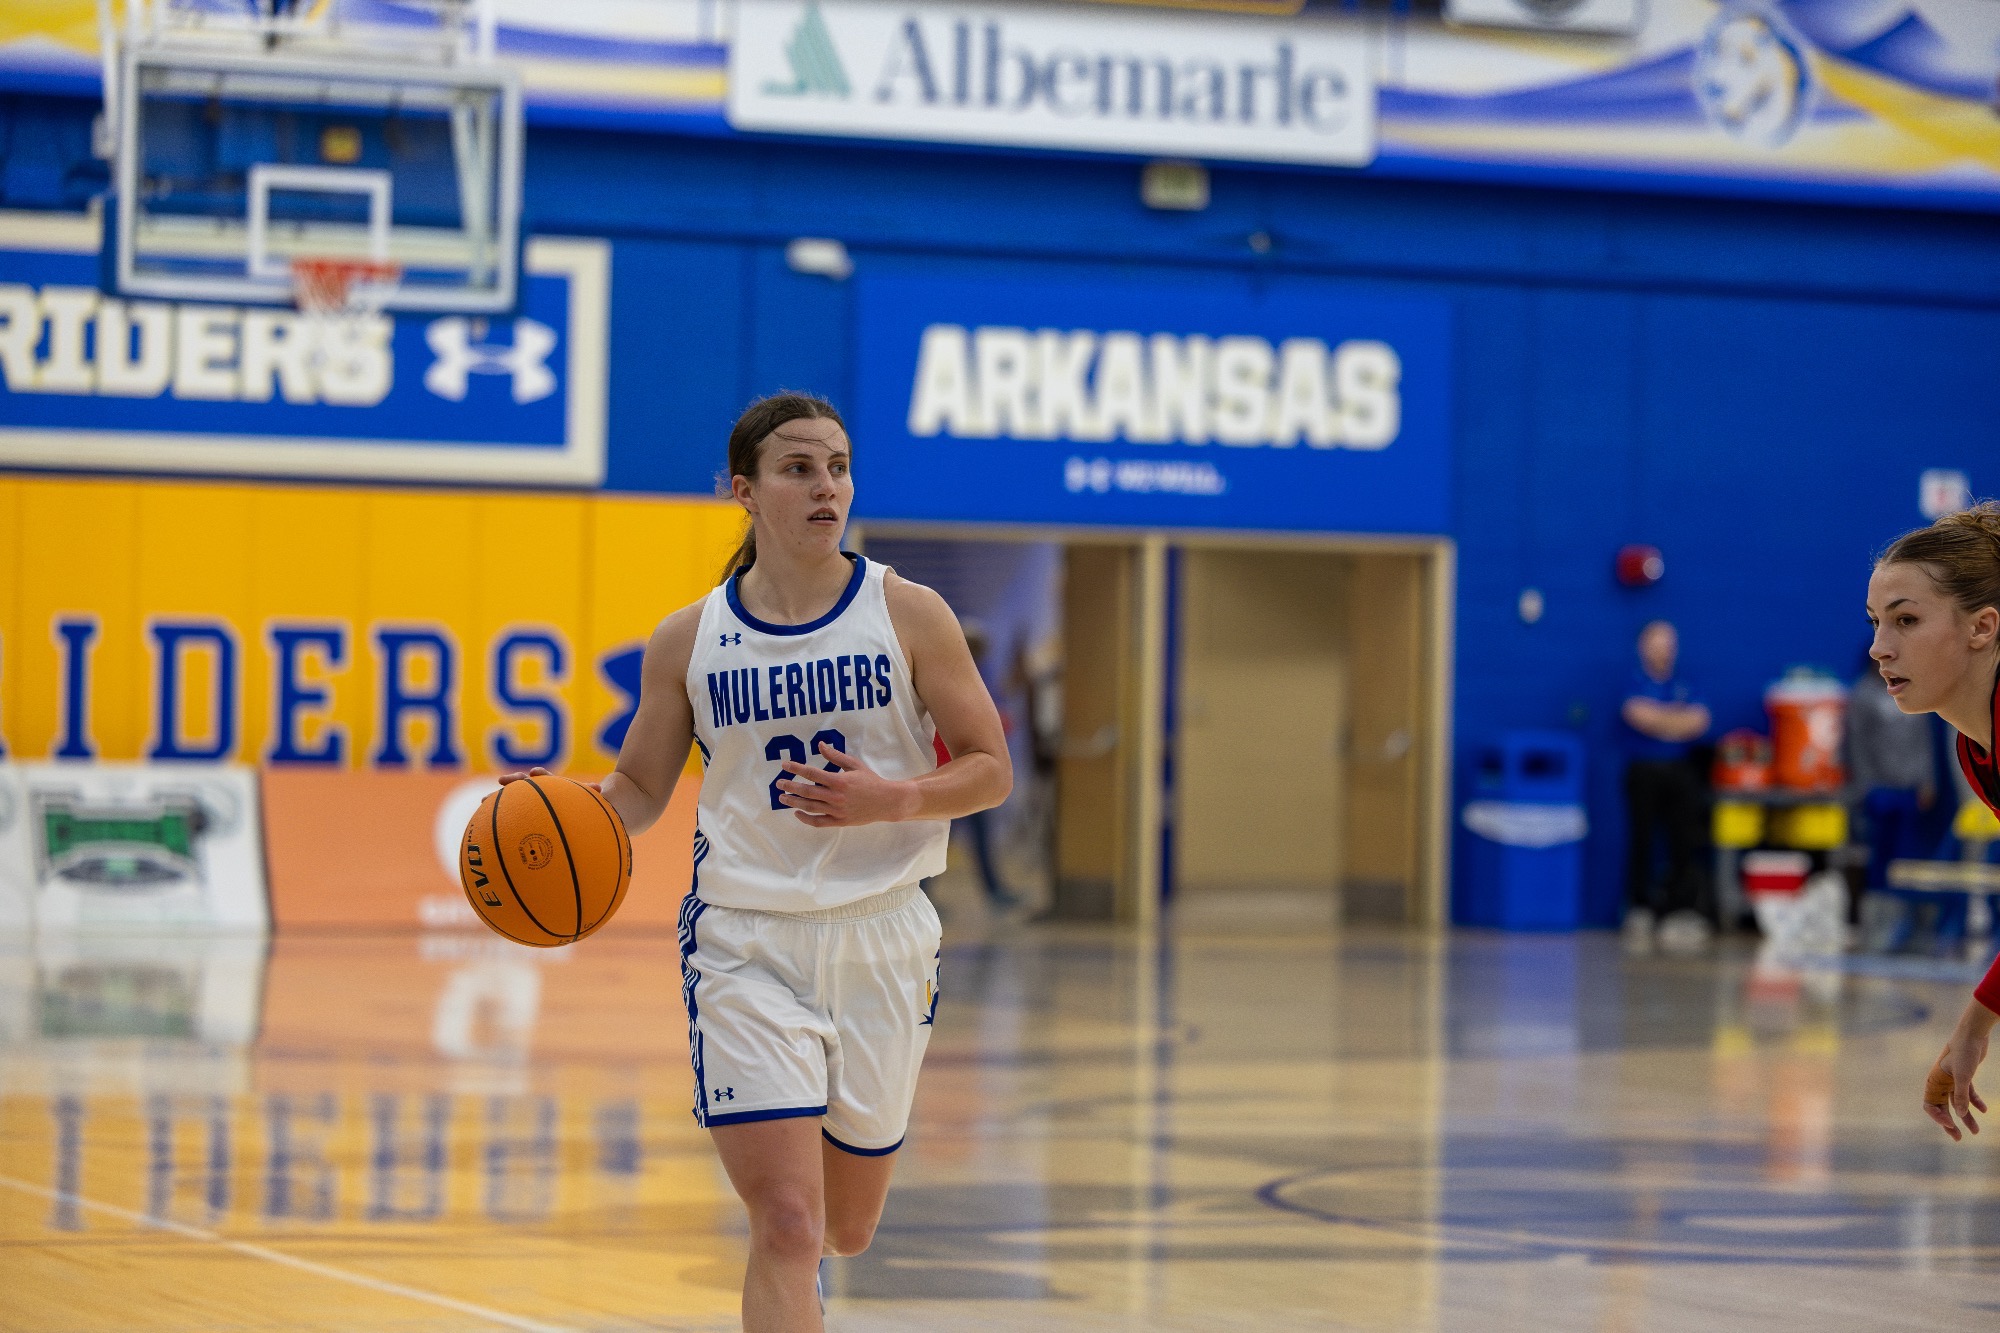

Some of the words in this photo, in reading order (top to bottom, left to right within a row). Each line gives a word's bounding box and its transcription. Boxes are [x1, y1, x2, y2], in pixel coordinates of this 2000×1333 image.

[874, 12, 1352, 137] Albemarle
[908, 323, 1402, 452] ARKANSAS
[0, 616, 568, 768] IDERS
[706, 654, 893, 729] MULERIDERS
[467, 845, 502, 906] EVO
